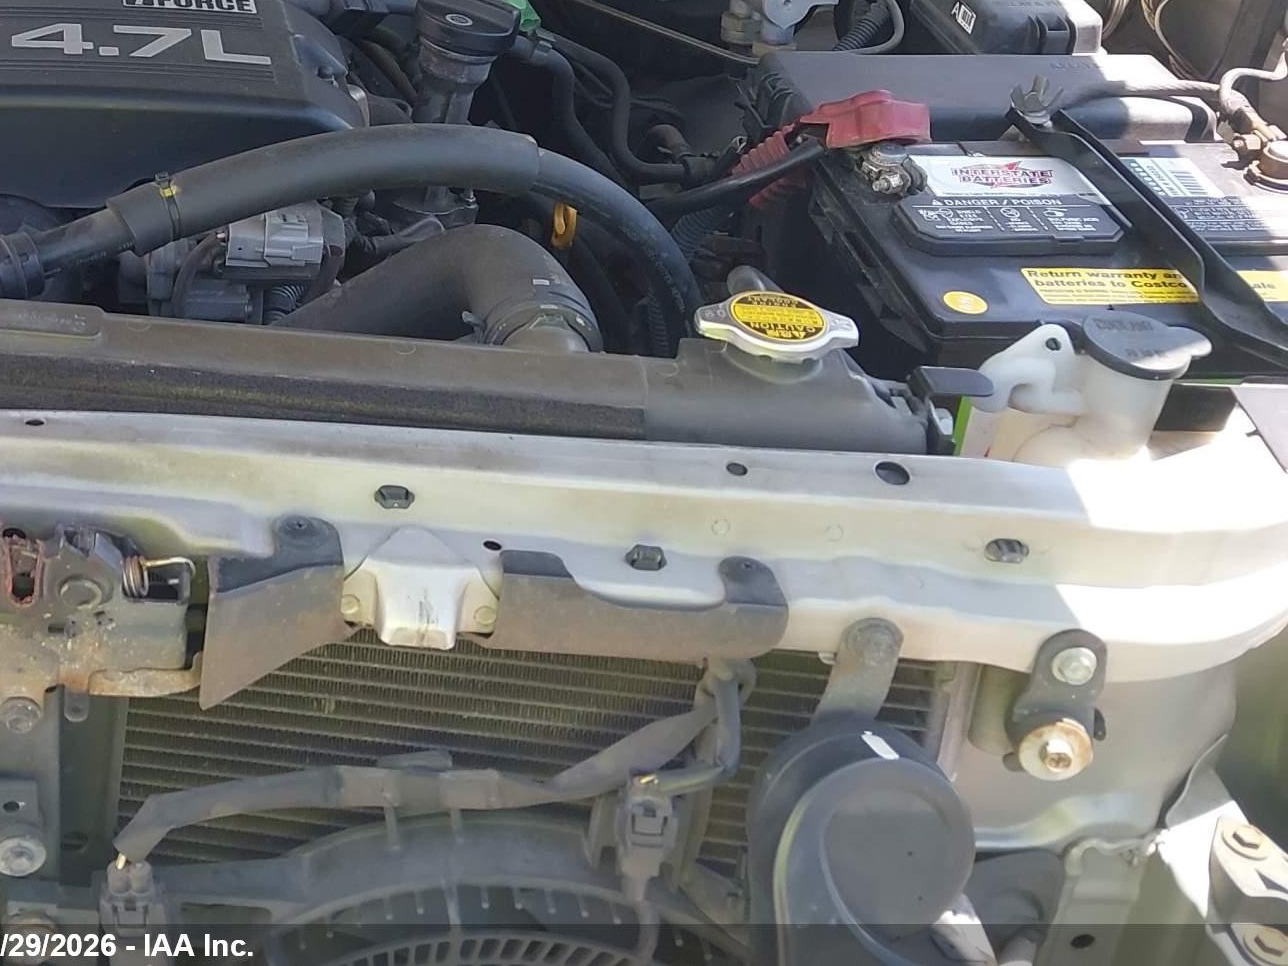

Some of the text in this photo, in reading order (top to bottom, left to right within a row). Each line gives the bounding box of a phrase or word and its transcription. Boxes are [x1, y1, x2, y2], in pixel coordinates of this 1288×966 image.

[11, 22, 273, 66] 4.7L
[951, 168, 1054, 178] INTERSTATE
[959, 176, 1052, 185] BATTERIES
[1011, 198, 1063, 206] POISON
[1027, 270, 1082, 278] Return
[1086, 271, 1158, 280] warranty
[1034, 279, 1188, 289] batteries to Costco
[749, 321, 816, 333] CAUTION
